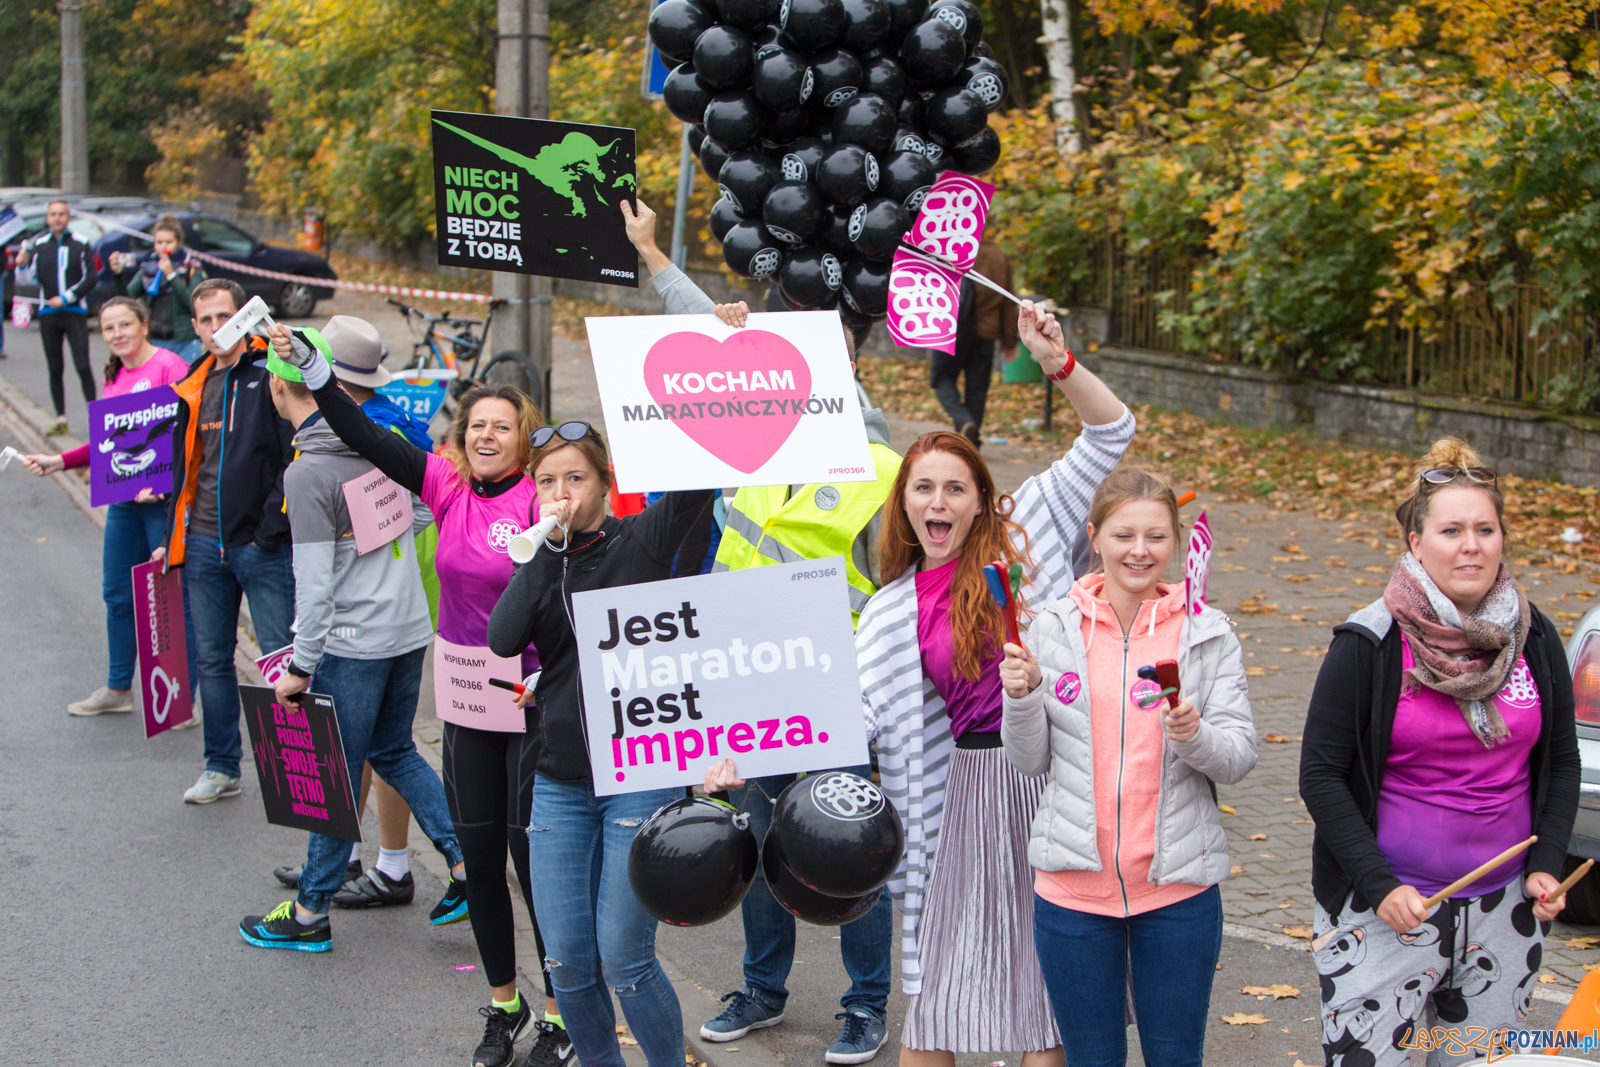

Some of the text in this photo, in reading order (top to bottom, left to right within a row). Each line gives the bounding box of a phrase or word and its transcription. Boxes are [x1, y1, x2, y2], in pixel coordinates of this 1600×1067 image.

[444, 165, 519, 191] NIECH
[446, 188, 520, 219] MOC
[447, 216, 521, 240] BĘDZIE
[447, 238, 523, 266] Z TOBĄ
[600, 268, 635, 279] #PRO366
[662, 369, 796, 395] KOCHAM
[104, 402, 179, 431] Przyspiesz
[622, 394, 844, 422] MARATOŃCZYKÓW
[105, 467, 143, 485] Ludzie
[828, 466, 866, 475] #PRO366
[374, 490, 398, 510] PRO366
[377, 518, 391, 530] DLA
[790, 568, 838, 582] #PRO366
[146, 572, 160, 657] KOCHAM
[160, 572, 171, 651] KOBIETY
[597, 601, 700, 650] Jest
[443, 652, 486, 668] WSPIERAMY
[601, 635, 832, 693] Maraton,
[451, 676, 482, 691] PRO366
[271, 703, 286, 725] ZE
[452, 699, 486, 714] DLA KASI
[610, 683, 703, 740] jest
[276, 727, 315, 750] POZNASZ
[281, 748, 320, 777] SWOJE
[286, 773, 325, 806] TĘTNO
[291, 802, 329, 821] MAKSYMALNE
